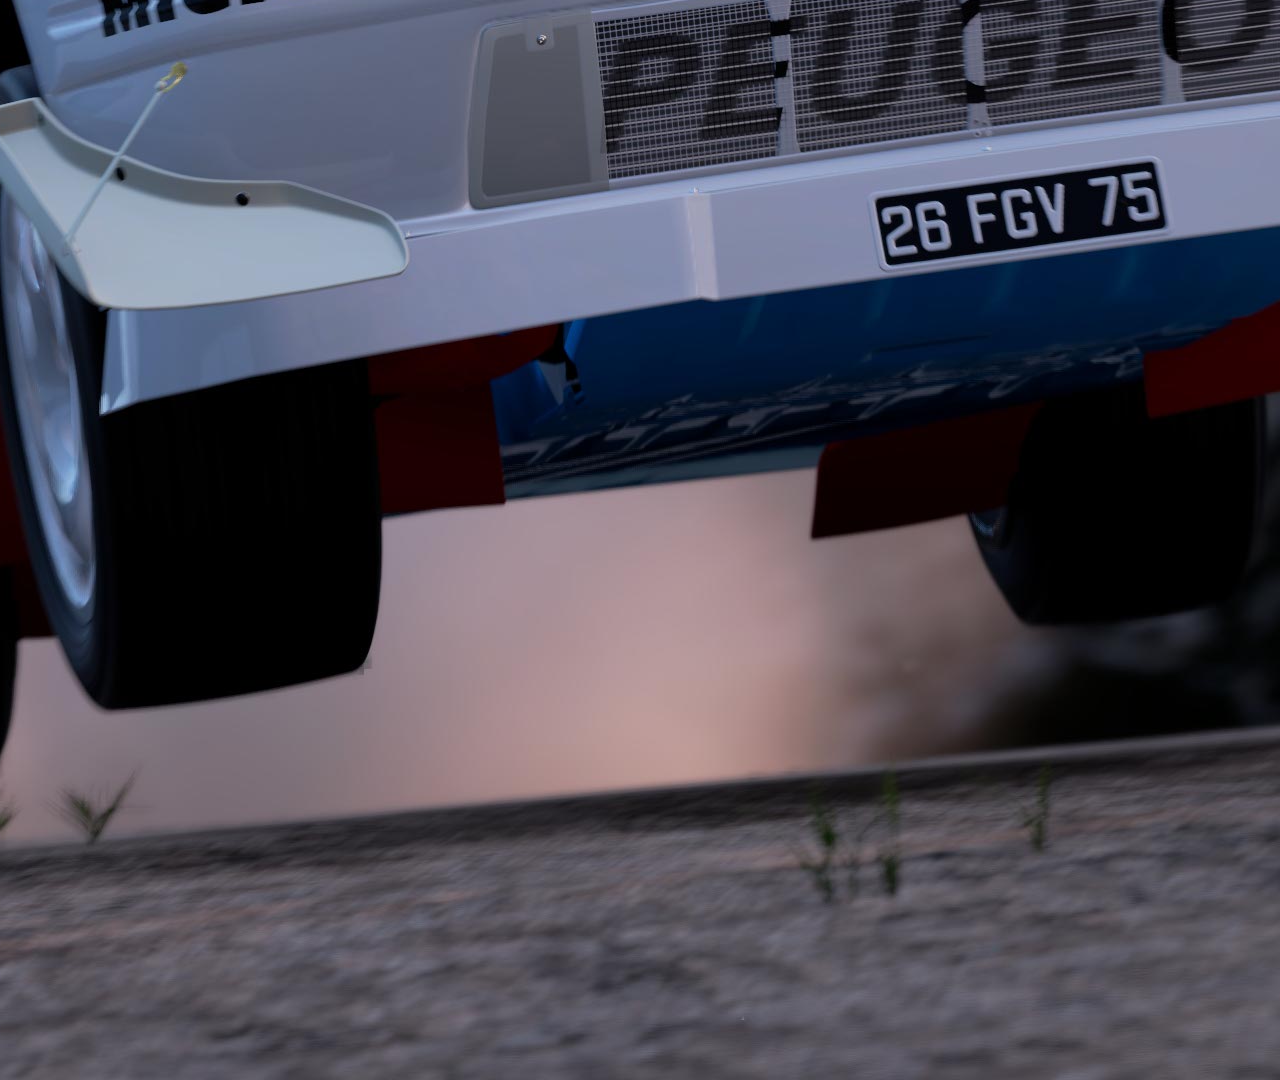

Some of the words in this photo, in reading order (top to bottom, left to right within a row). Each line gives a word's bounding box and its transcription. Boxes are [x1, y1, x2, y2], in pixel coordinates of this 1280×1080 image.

[881, 200, 952, 258] 26
[966, 182, 1065, 245] FGV
[1087, 171, 1161, 228] 75
